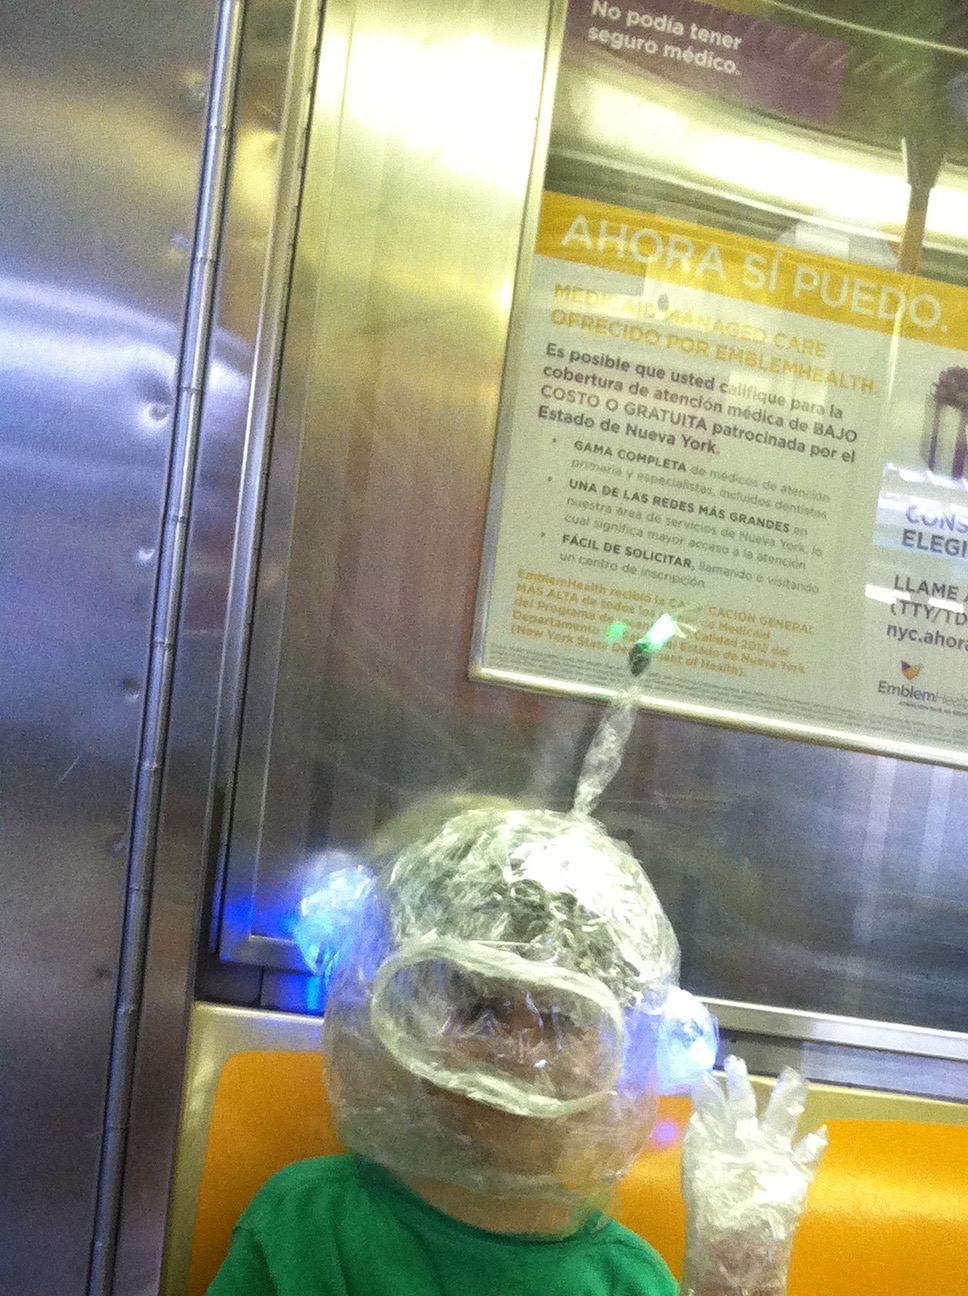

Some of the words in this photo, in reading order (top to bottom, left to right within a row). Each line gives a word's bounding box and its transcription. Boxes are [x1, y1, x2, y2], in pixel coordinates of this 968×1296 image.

[586, 22, 659, 59] seguro
[662, 38, 743, 76] médico.
[590, 0, 622, 21] No
[625, 4, 686, 40] podía
[688, 22, 743, 52] tener
[560, 209, 730, 283] AHORA
[740, 242, 783, 295] SÍ
[791, 263, 953, 335] PUEDO.
[549, 306, 662, 347] OFRECIDO
[664, 331, 711, 357] POR
[663, 305, 768, 346] MANAGED
[772, 330, 828, 359] CARE
[542, 362, 624, 393] cobertura
[627, 380, 650, 398] de
[652, 385, 724, 414] atención
[726, 401, 784, 427] médica
[787, 415, 810, 433] de
[812, 420, 858, 444] BAJO
[545, 342, 565, 359] Es
[568, 345, 629, 376] posible
[634, 362, 665, 383] que
[669, 368, 716, 392] usted
[717, 378, 786, 410] califique
[789, 396, 827, 418] para
[828, 404, 844, 421] la
[536, 404, 596, 429] Estado
[599, 417, 621, 435] de
[624, 422, 677, 447] Nueva
[679, 434, 722, 456] York.
[539, 383, 601, 409] COSTO
[604, 397, 620, 413] O
[622, 400, 709, 432] GRATUITA
[711, 419, 807, 456] patrocinada
[808, 442, 837, 462] por
[840, 447, 856, 464] el
[570, 457, 622, 478] primaria
[625, 470, 633, 481] y
[718, 487, 772, 509] incluidos
[773, 498, 828, 520] dentistas
[573, 439, 613, 458] GAMA
[616, 448, 687, 473] COMPLETA
[689, 463, 707, 477] de
[761, 478, 777, 492] de
[565, 496, 612, 515] nuestra
[645, 511, 662, 524] de
[664, 515, 717, 536] servicios
[719, 526, 736, 540] de
[737, 530, 776, 548] Nueva
[568, 478, 598, 494] UNA
[601, 484, 619, 498] DE
[622, 488, 650, 504] LAS
[651, 494, 695, 513] REDES
[697, 502, 726, 520] MÁS
[728, 510, 790, 533] GRANDES
[792, 525, 808, 537] en
[561, 530, 600, 551] FÁCIL
[602, 541, 621, 555] DE
[623, 545, 696, 571] SOLICITAR,
[697, 560, 753, 581] llamando
[766, 574, 820, 595] visitando
[563, 512, 590, 528] cual
[592, 517, 644, 541] significa
[646, 530, 685, 548] mayor
[687, 538, 730, 555] acceso
[731, 546, 740, 557] a
[741, 547, 754, 560] la
[558, 551, 576, 563] un
[577, 555, 618, 572] centro
[620, 561, 638, 575] de
[892, 574, 959, 601] LLAME
[513, 594, 534, 609] del
[535, 599, 596, 622] Programa
[517, 568, 607, 595] EmblemHealth
[758, 614, 816, 635] GENERAL
[546, 588, 579, 603] ALTA
[580, 594, 598, 607] de
[599, 598, 635, 614] todos
[546, 629, 574, 644] York
